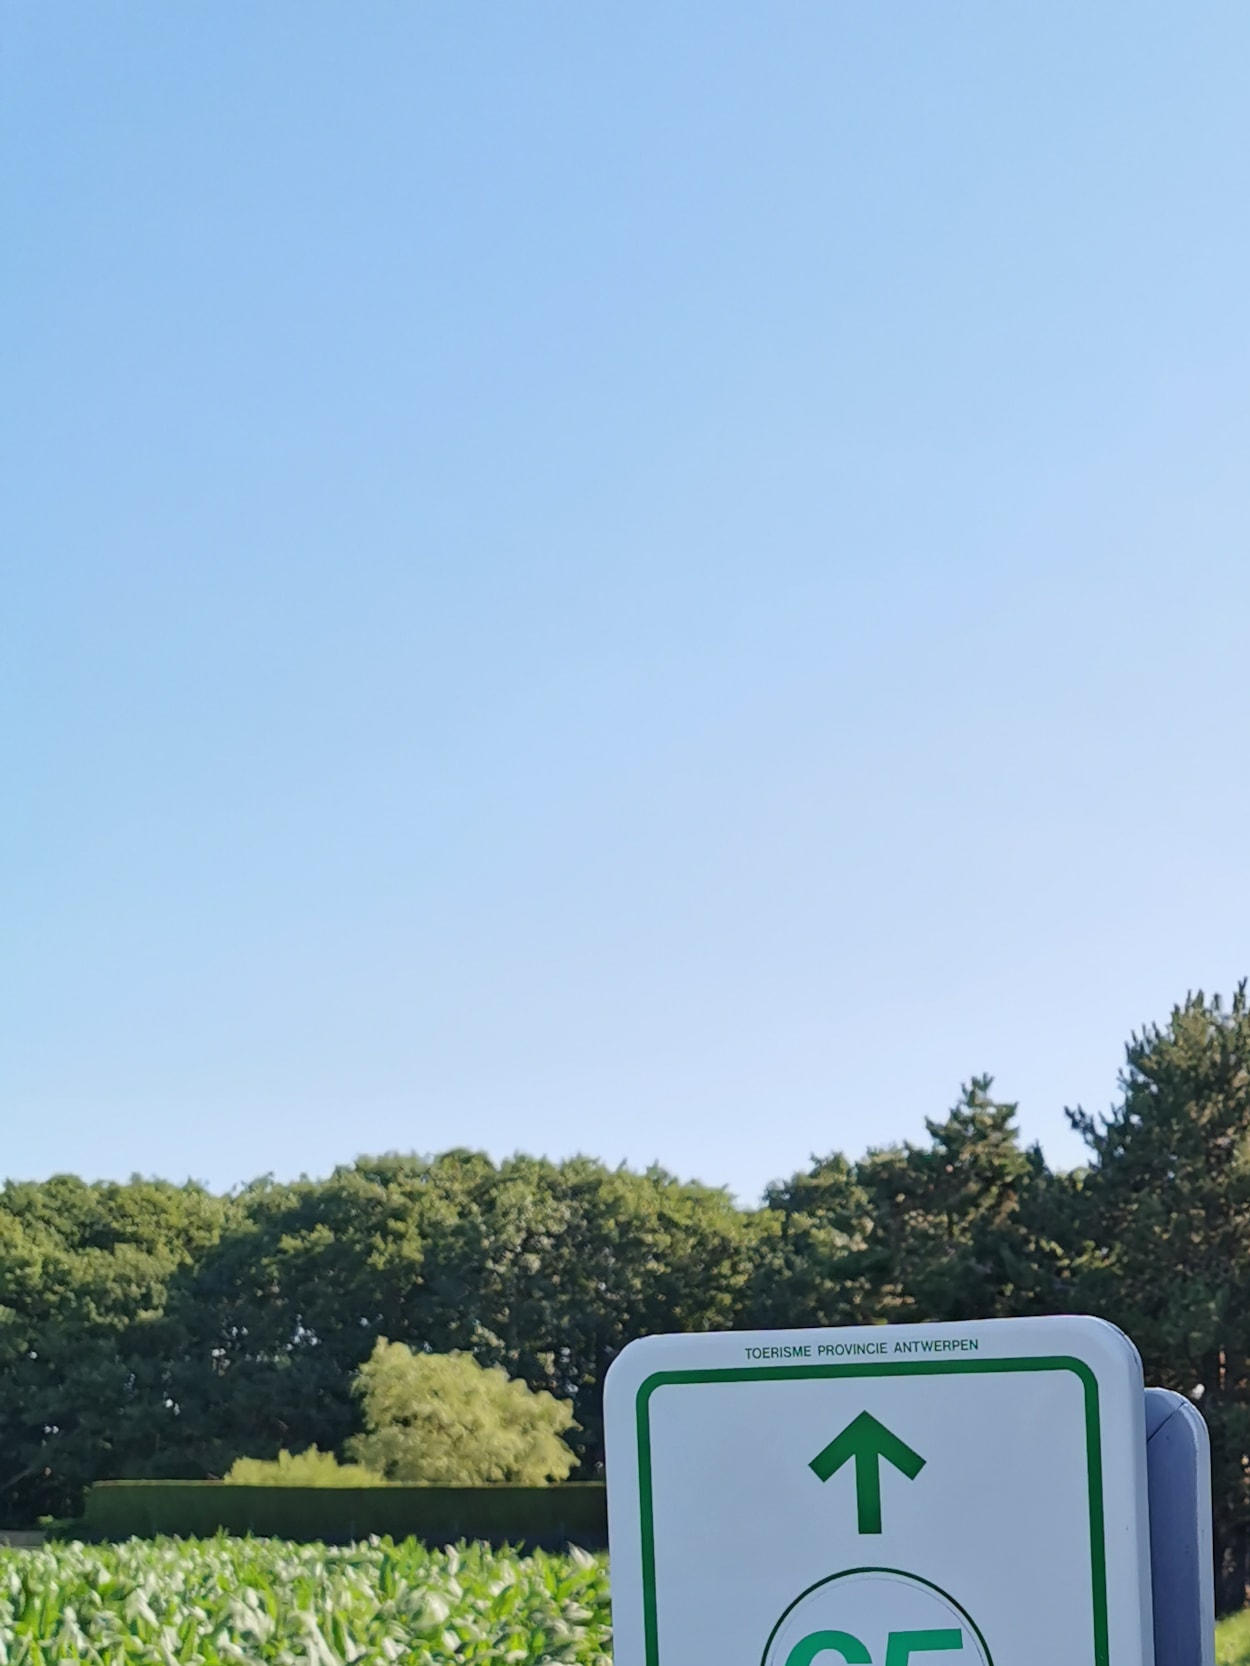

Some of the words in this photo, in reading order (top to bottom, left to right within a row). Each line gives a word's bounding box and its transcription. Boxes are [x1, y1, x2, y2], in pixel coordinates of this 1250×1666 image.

[745, 1345, 812, 1360] TOERISME
[817, 1342, 888, 1358] PROVINCIE
[893, 1338, 979, 1354] ANTWERPEN
